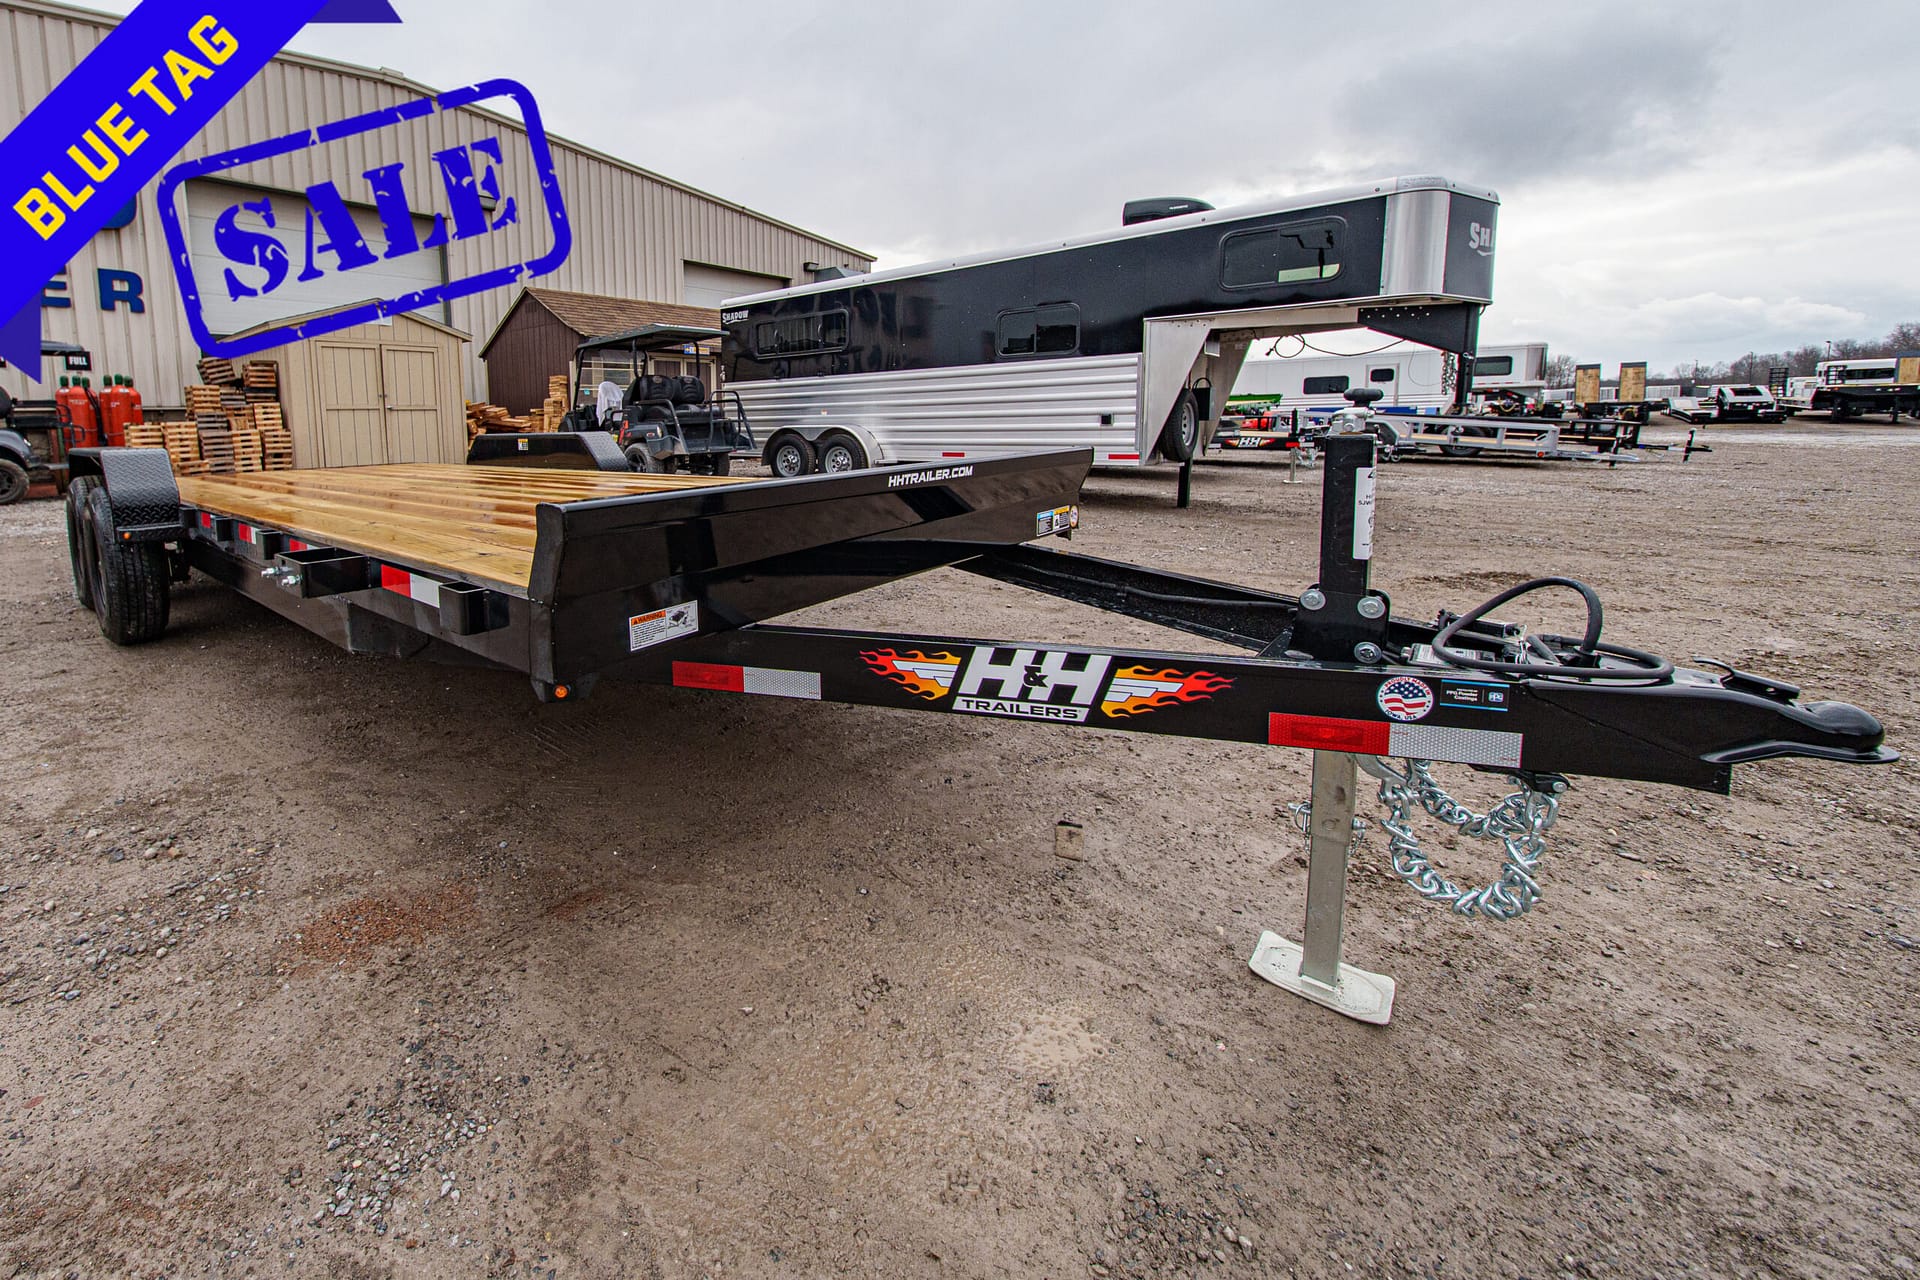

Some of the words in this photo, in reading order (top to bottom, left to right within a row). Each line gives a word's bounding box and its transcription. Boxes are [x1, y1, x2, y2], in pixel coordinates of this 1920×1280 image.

[722, 310, 749, 323] SHADOW
[69, 355, 88, 366] FULL
[888, 465, 973, 488] HHTRAILER.COM
[956, 646, 1112, 705] H&H
[961, 700, 1079, 720] TRAILERS
